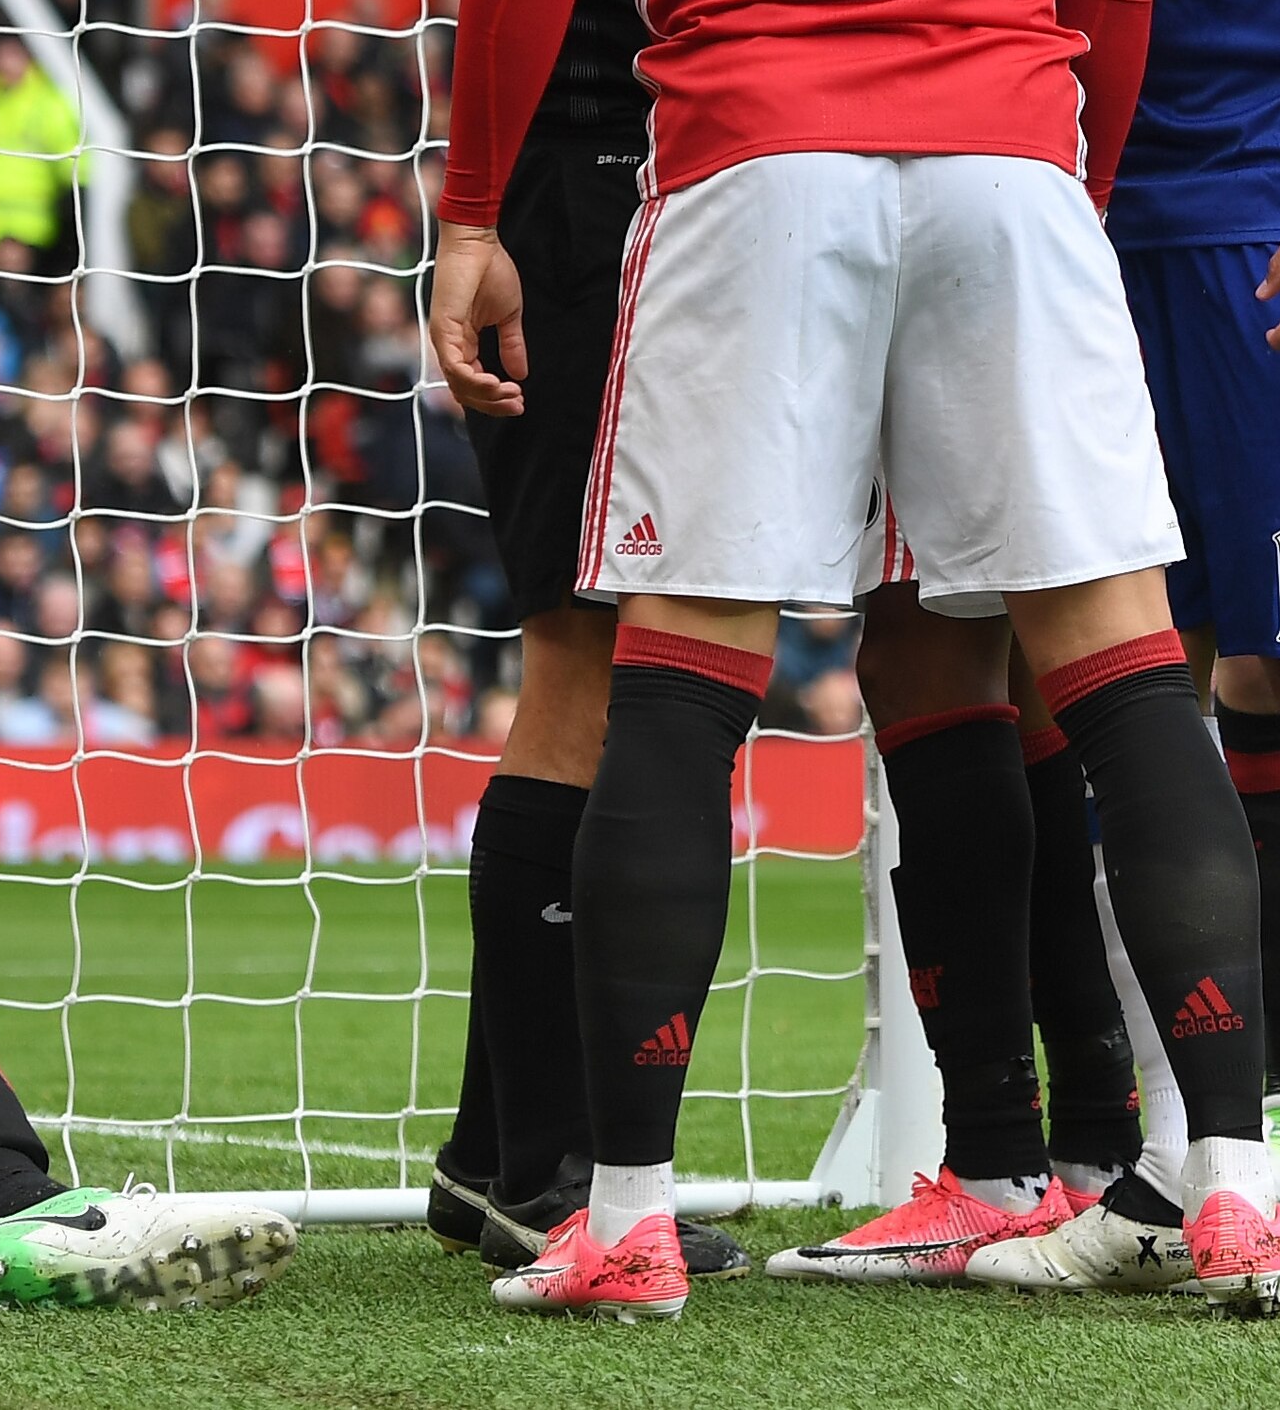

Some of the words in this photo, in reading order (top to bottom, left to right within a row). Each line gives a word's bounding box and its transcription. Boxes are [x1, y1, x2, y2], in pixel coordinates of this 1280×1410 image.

[596, 155, 640, 165] DRI-FIT
[614, 540, 663, 556] adidas
[1172, 1014, 1244, 1039] adidas
